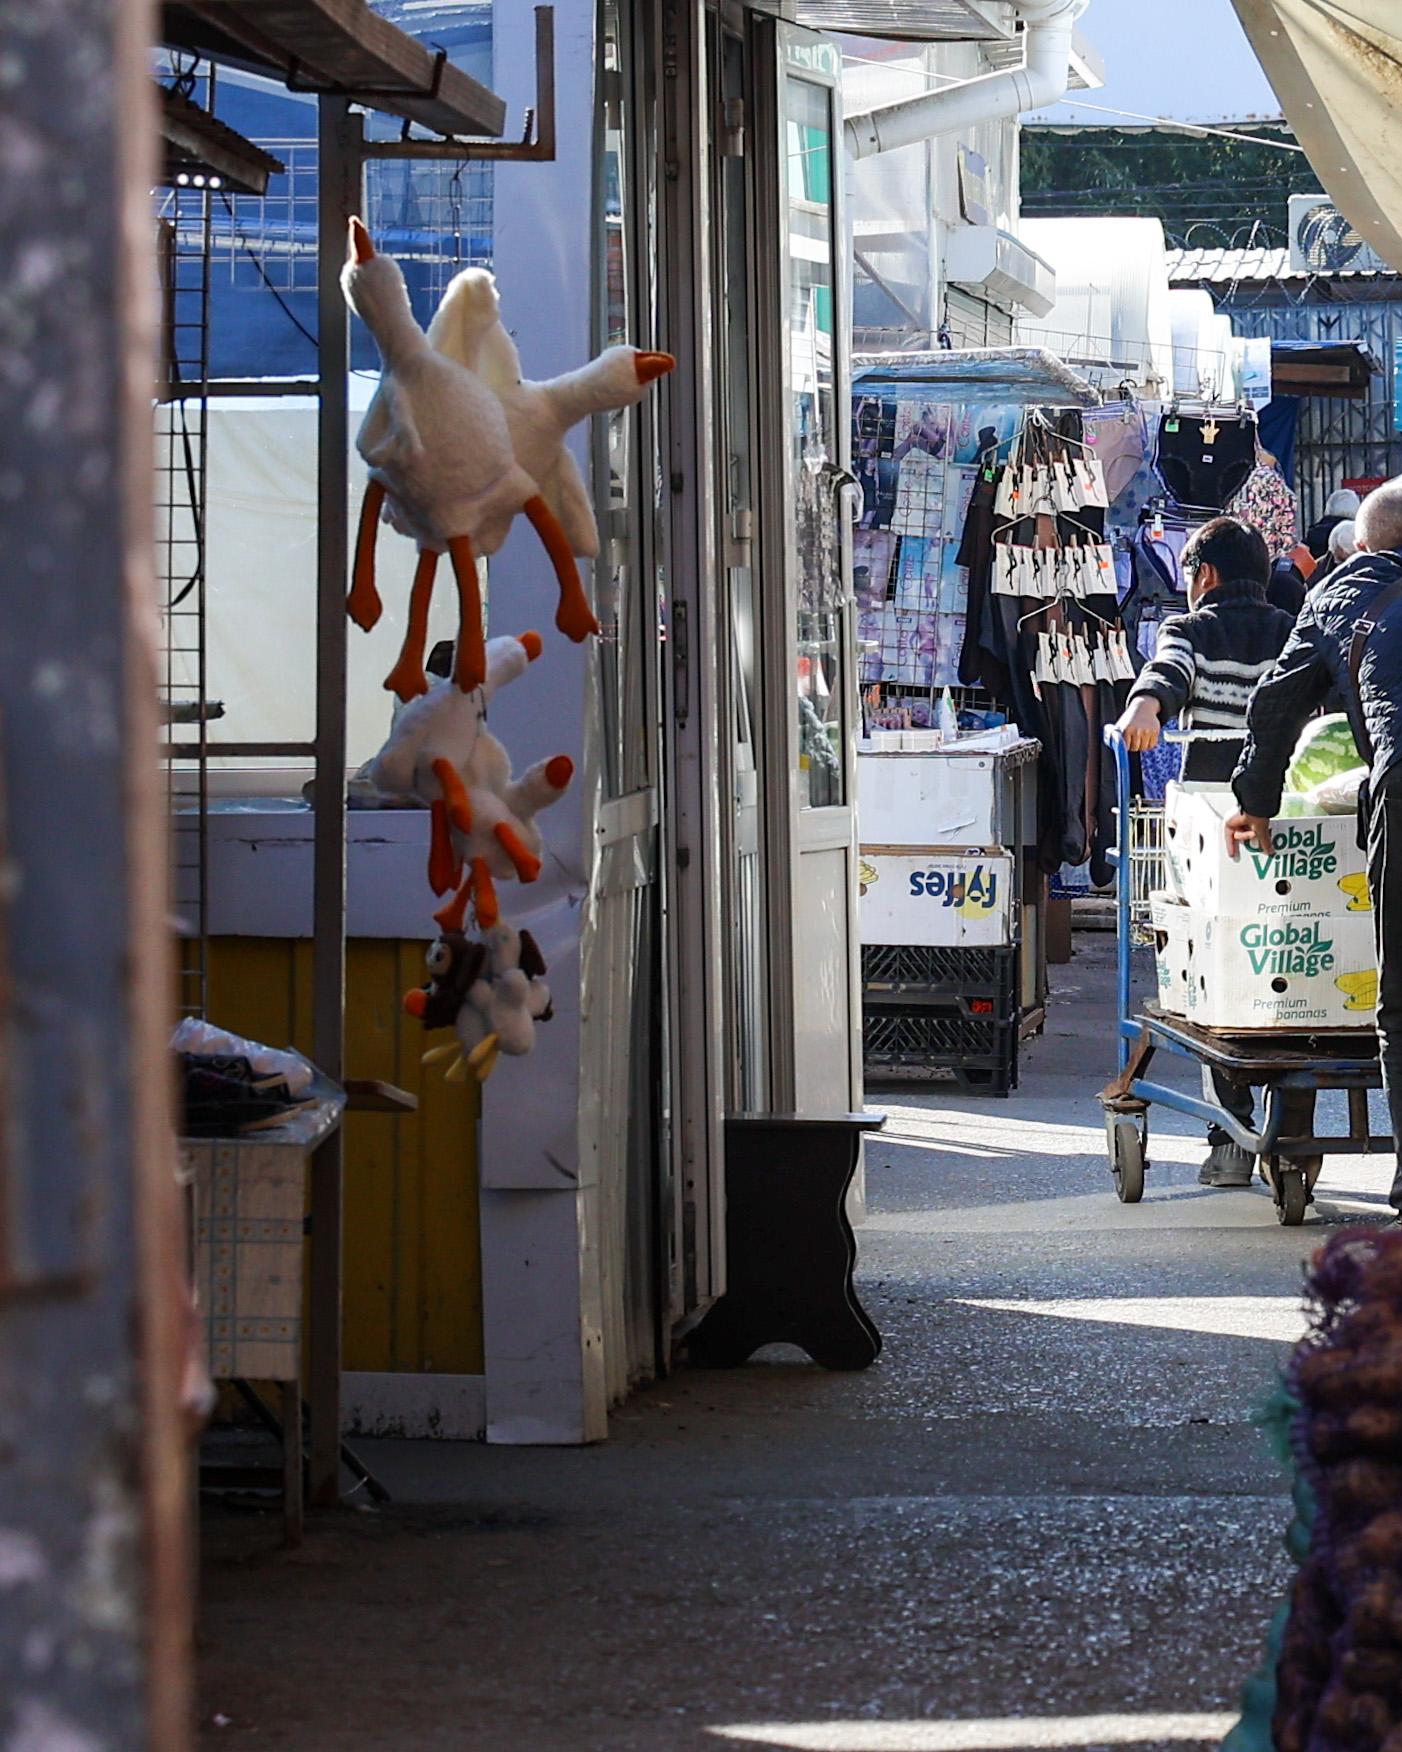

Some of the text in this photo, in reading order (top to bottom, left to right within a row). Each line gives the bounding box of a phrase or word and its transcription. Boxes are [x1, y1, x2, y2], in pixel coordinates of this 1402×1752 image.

[1244, 823, 1335, 852] obal
[1251, 853, 1337, 880] Village
[1257, 901, 1311, 914] Premium
[1240, 921, 1333, 948] Global
[1247, 949, 1334, 977] Village
[1253, 997, 1307, 1010] Premium
[1276, 1009, 1327, 1020] bananas
